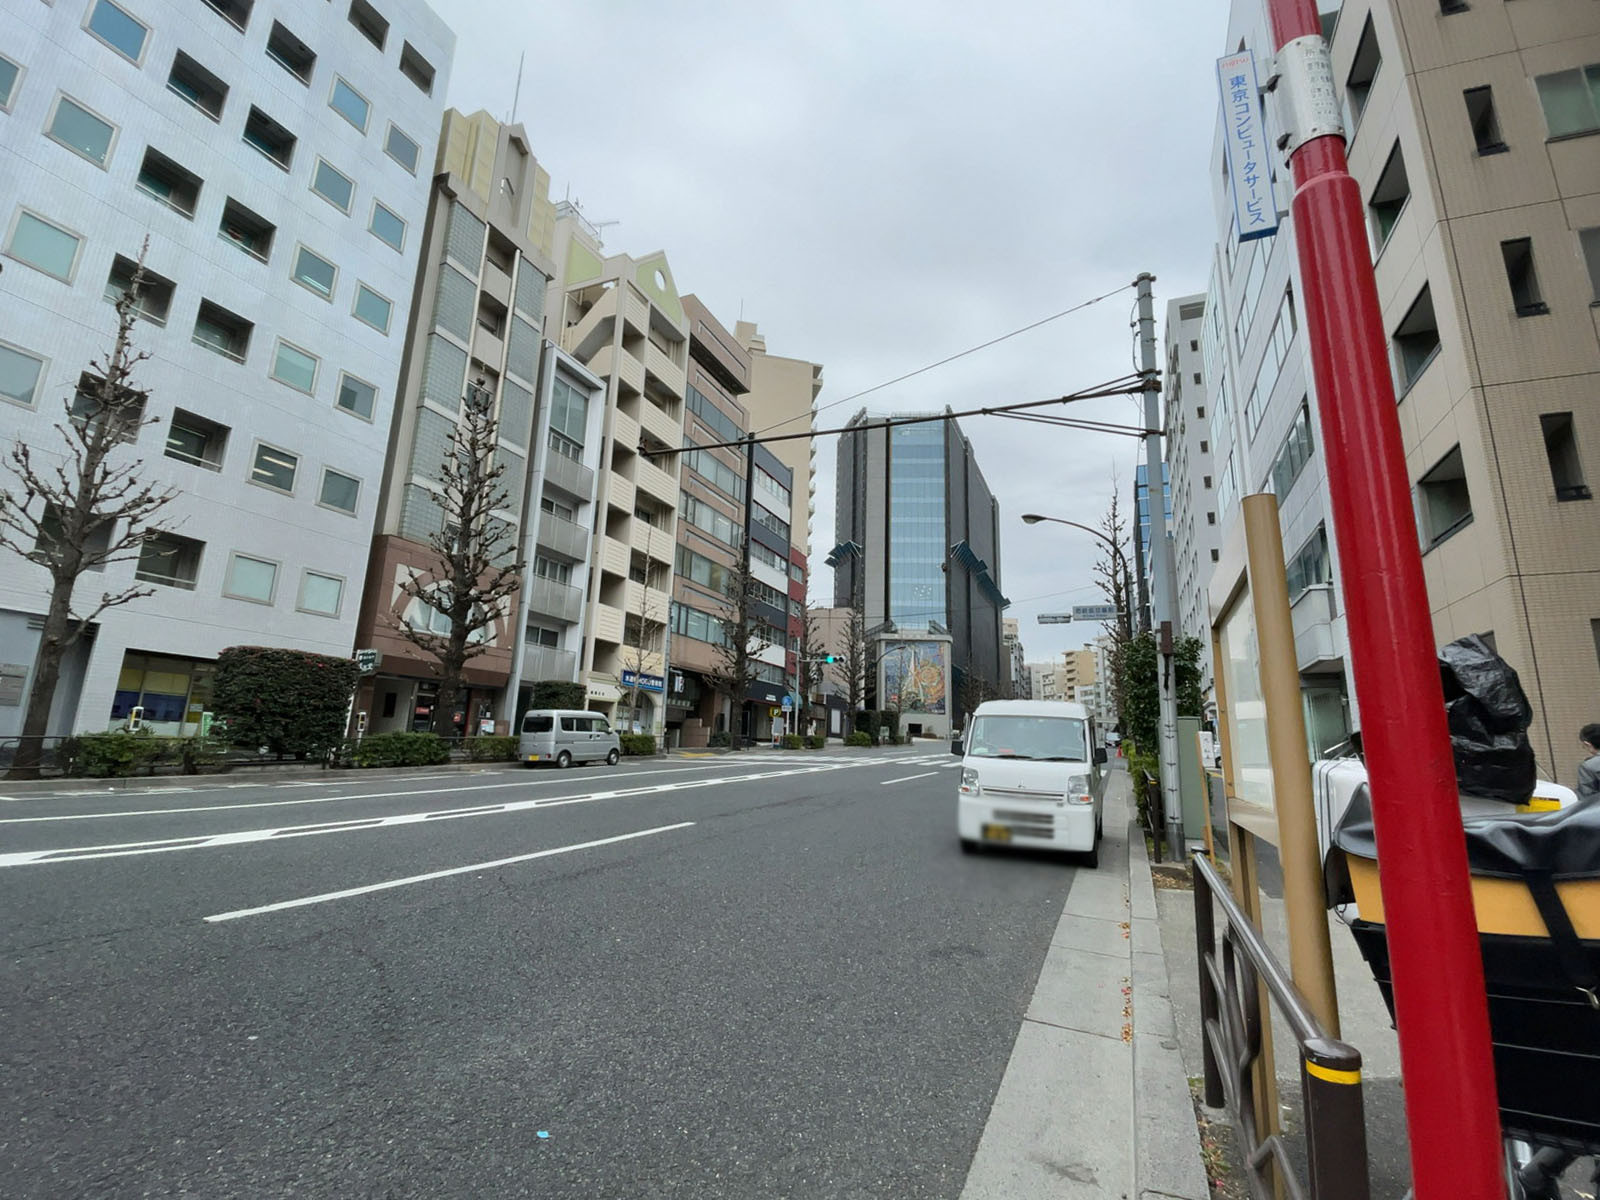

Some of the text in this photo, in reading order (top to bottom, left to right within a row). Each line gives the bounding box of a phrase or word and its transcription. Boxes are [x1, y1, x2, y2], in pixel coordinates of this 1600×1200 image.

[1228, 74, 1266, 225] 東京コンピュータサービス
